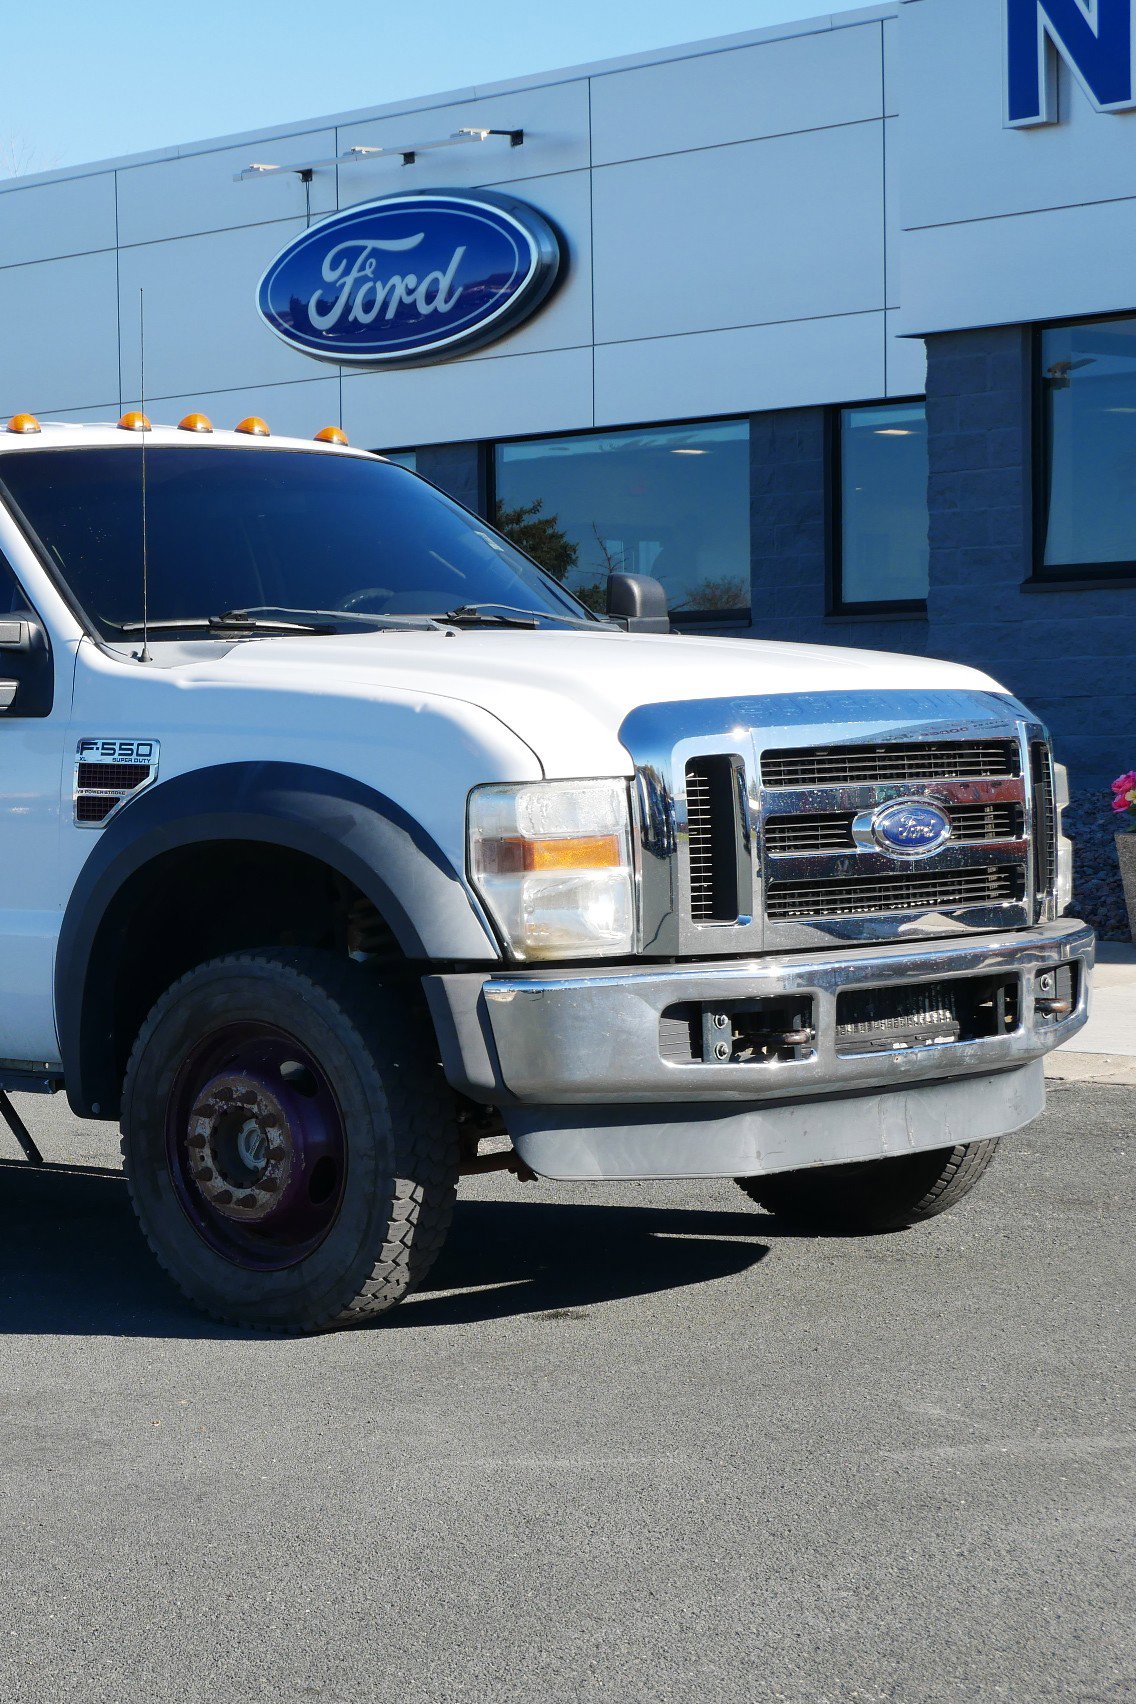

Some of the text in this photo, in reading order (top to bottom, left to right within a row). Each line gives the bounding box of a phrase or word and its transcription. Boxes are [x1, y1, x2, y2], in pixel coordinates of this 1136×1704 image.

[308, 232, 466, 330] Ford
[80, 742, 153, 757] F-550
[898, 814, 937, 839] Ford
